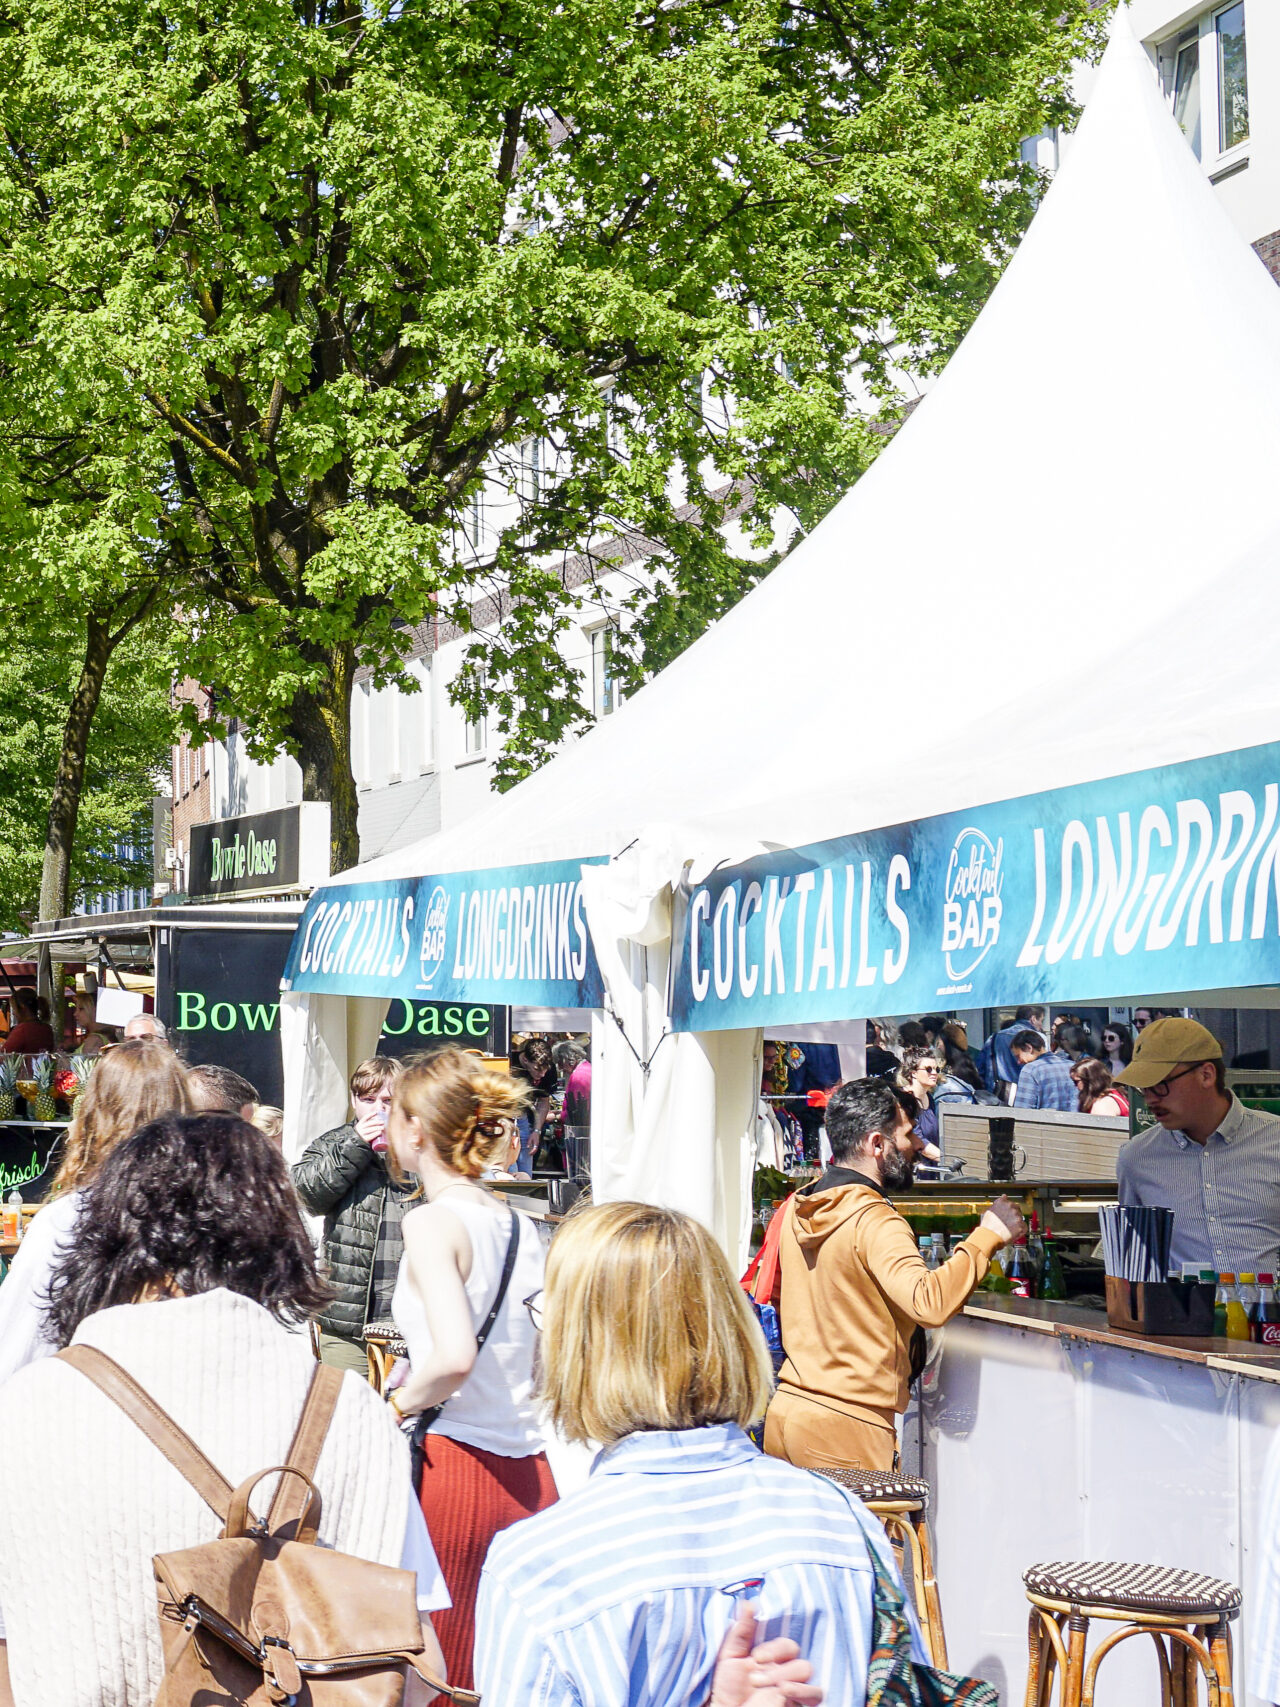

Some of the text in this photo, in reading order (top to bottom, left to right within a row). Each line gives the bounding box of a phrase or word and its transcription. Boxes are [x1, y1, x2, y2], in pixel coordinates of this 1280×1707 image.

[210, 834, 245, 882] Bowle
[247, 830, 277, 877] Oase
[945, 836, 1004, 904] Cocktail
[300, 896, 413, 978] COCKTAILS
[420, 929, 446, 961] BAR
[452, 880, 587, 980] LONGDRINKS
[691, 854, 910, 1002] COCKTAILS
[941, 897, 1003, 951] BAR
[176, 992, 284, 1031] Bow
